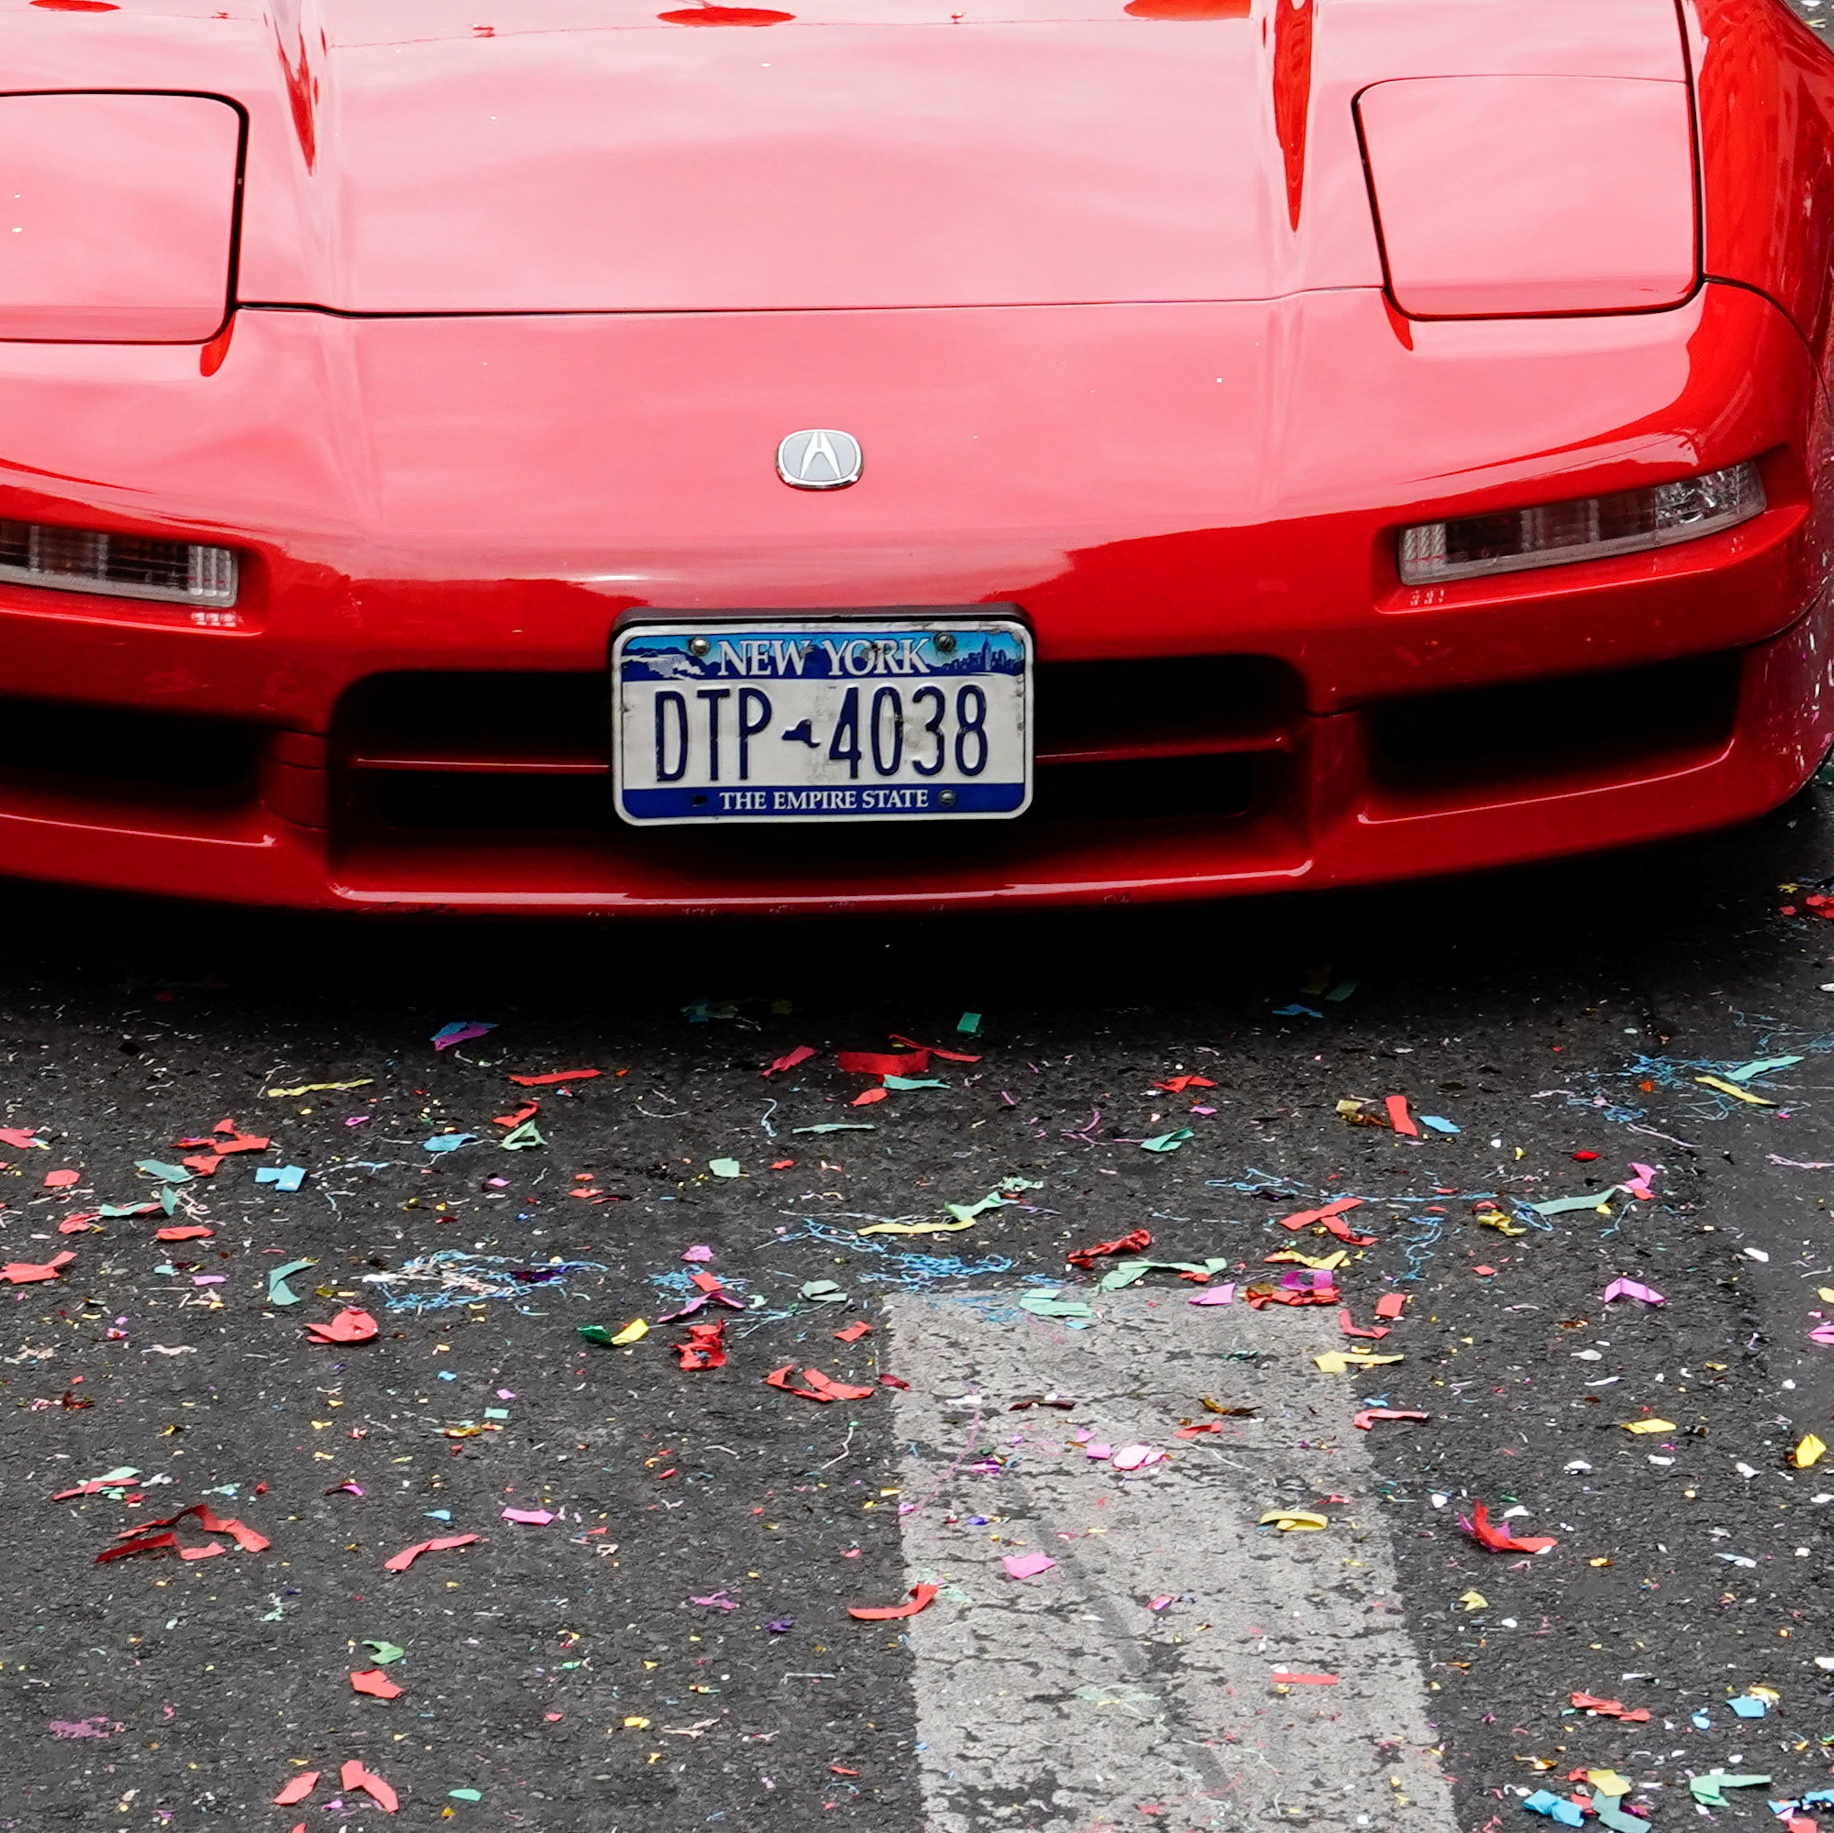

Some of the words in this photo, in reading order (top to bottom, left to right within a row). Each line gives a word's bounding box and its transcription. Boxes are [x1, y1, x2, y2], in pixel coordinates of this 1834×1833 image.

[717, 639, 812, 676] NEW
[821, 637, 931, 674] YORK
[654, 686, 773, 783] DTP
[828, 684, 989, 780] 4038
[719, 791, 768, 811] THE
[772, 790, 858, 811] EMPIRE
[862, 788, 930, 810] STATE
